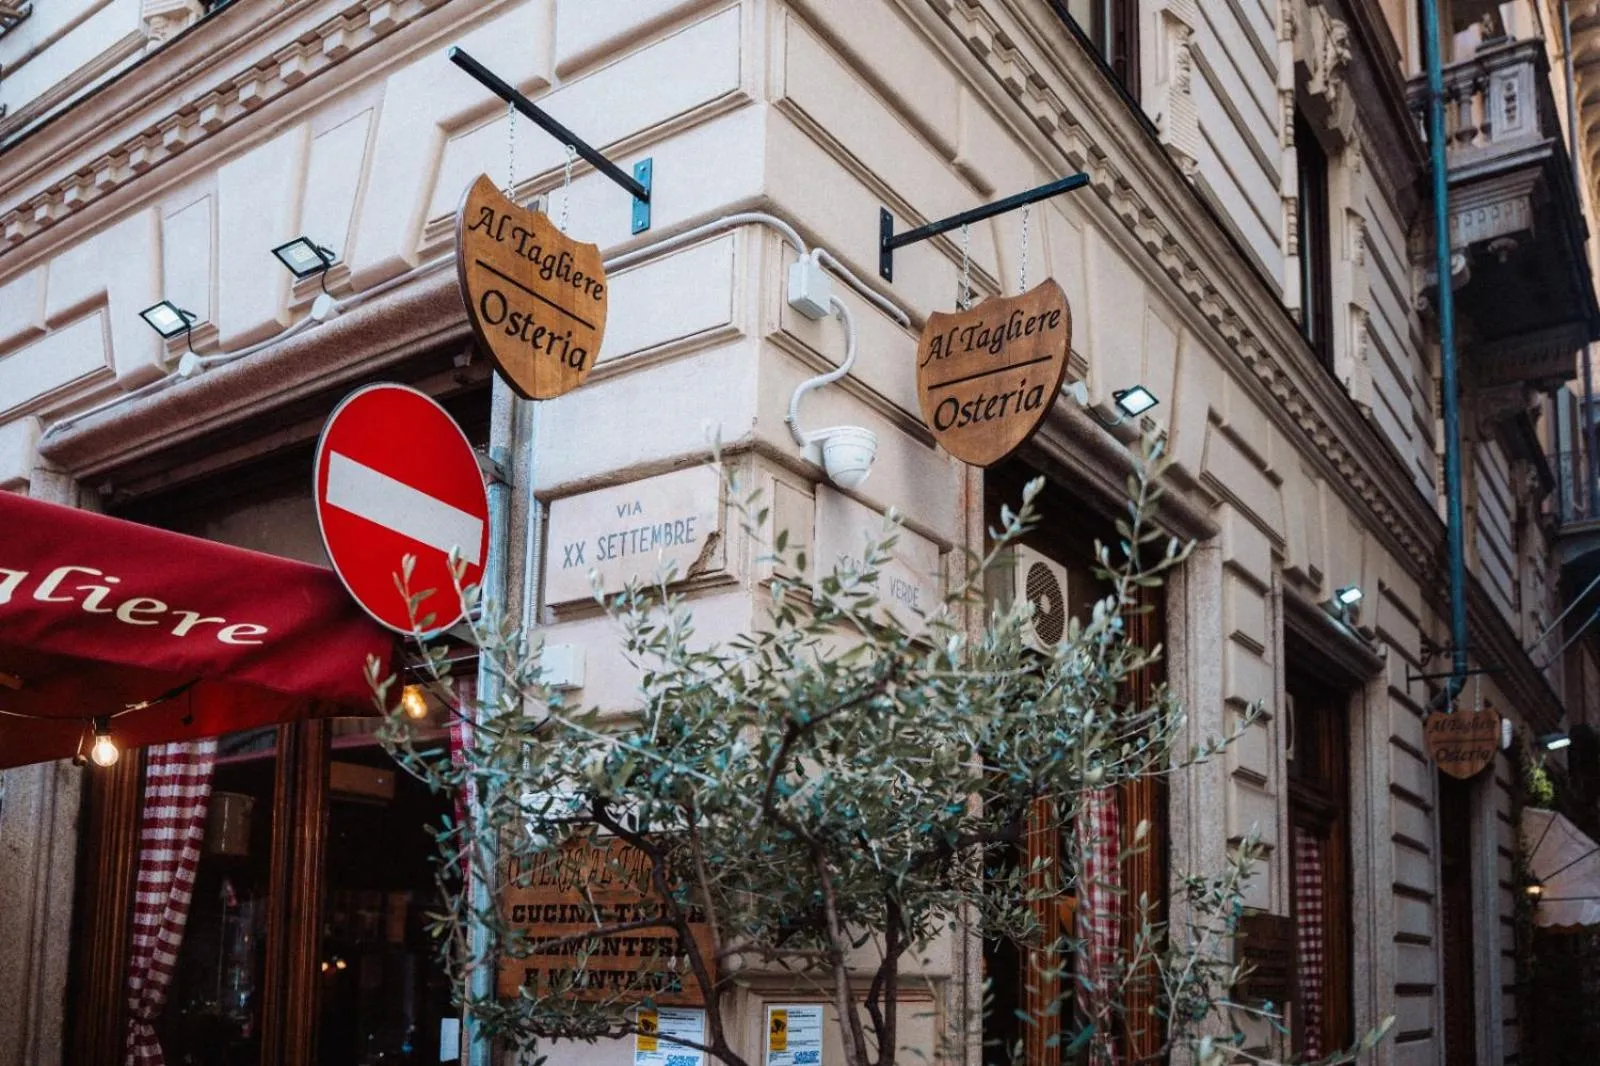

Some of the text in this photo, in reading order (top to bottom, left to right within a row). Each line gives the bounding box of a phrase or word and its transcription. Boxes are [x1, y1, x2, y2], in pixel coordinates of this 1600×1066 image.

[468, 206, 604, 300] Al Tagliere
[480, 289, 587, 371] Osteria
[920, 309, 1061, 368] Al Tagliere
[933, 378, 1045, 432] Osteria
[616, 501, 642, 518] VIA
[563, 516, 697, 569] XX SETTEMBRE
[889, 575, 919, 608] VERDE
